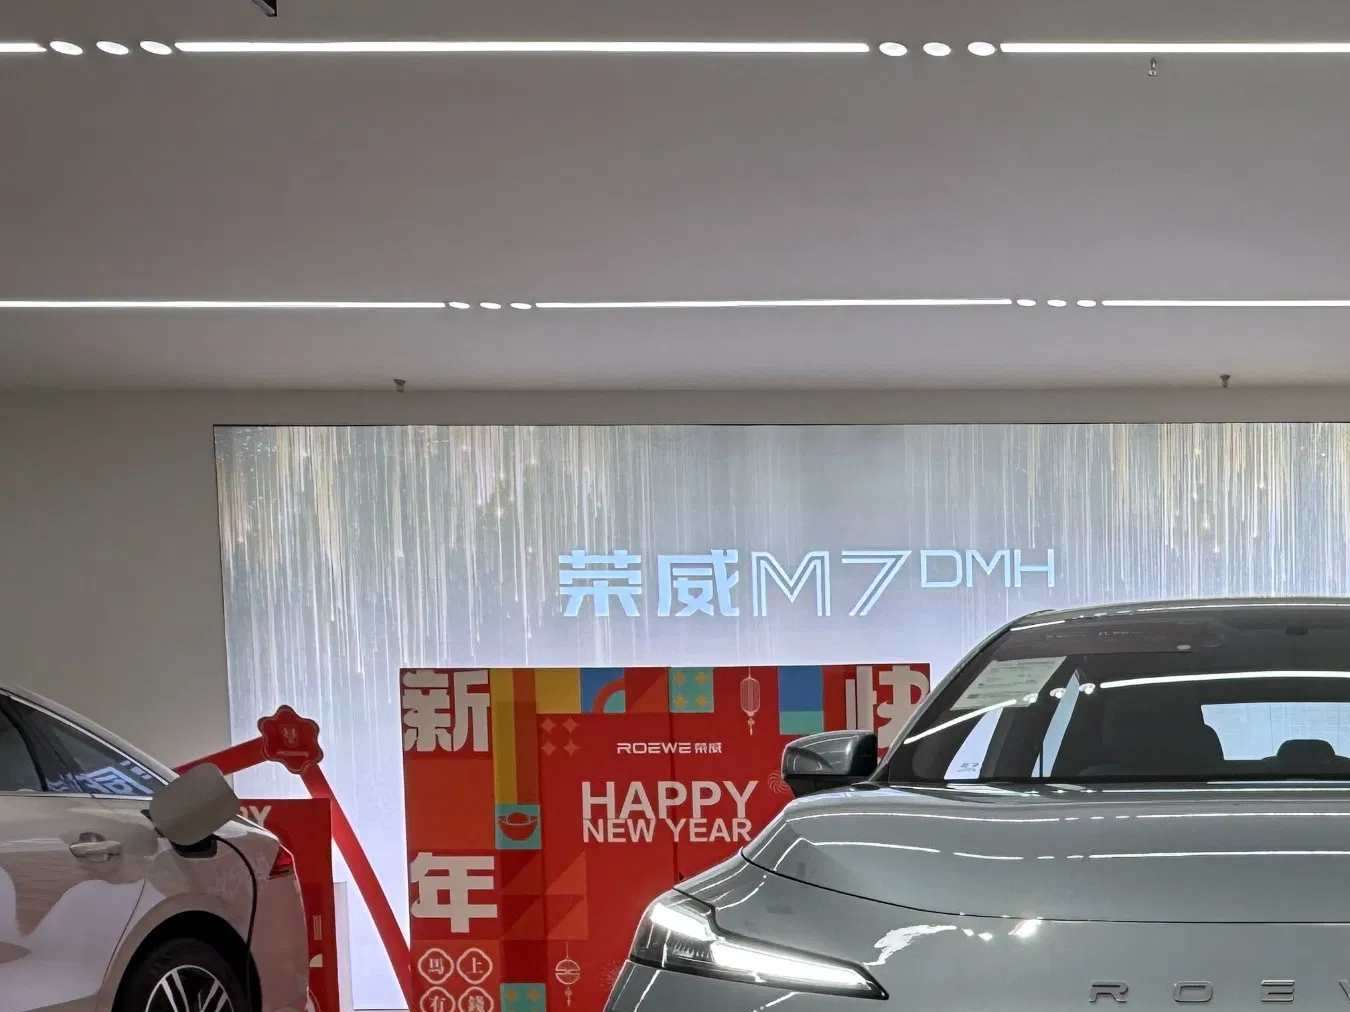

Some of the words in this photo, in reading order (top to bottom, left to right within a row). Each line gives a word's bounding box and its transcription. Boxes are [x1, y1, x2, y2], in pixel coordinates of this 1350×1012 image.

[919, 548, 1055, 588] DMH
[617, 741, 692, 754] ROEWE
[581, 780, 759, 820] HAPPY
[582, 818, 656, 843] NEW
[665, 817, 753, 842] YEAR
